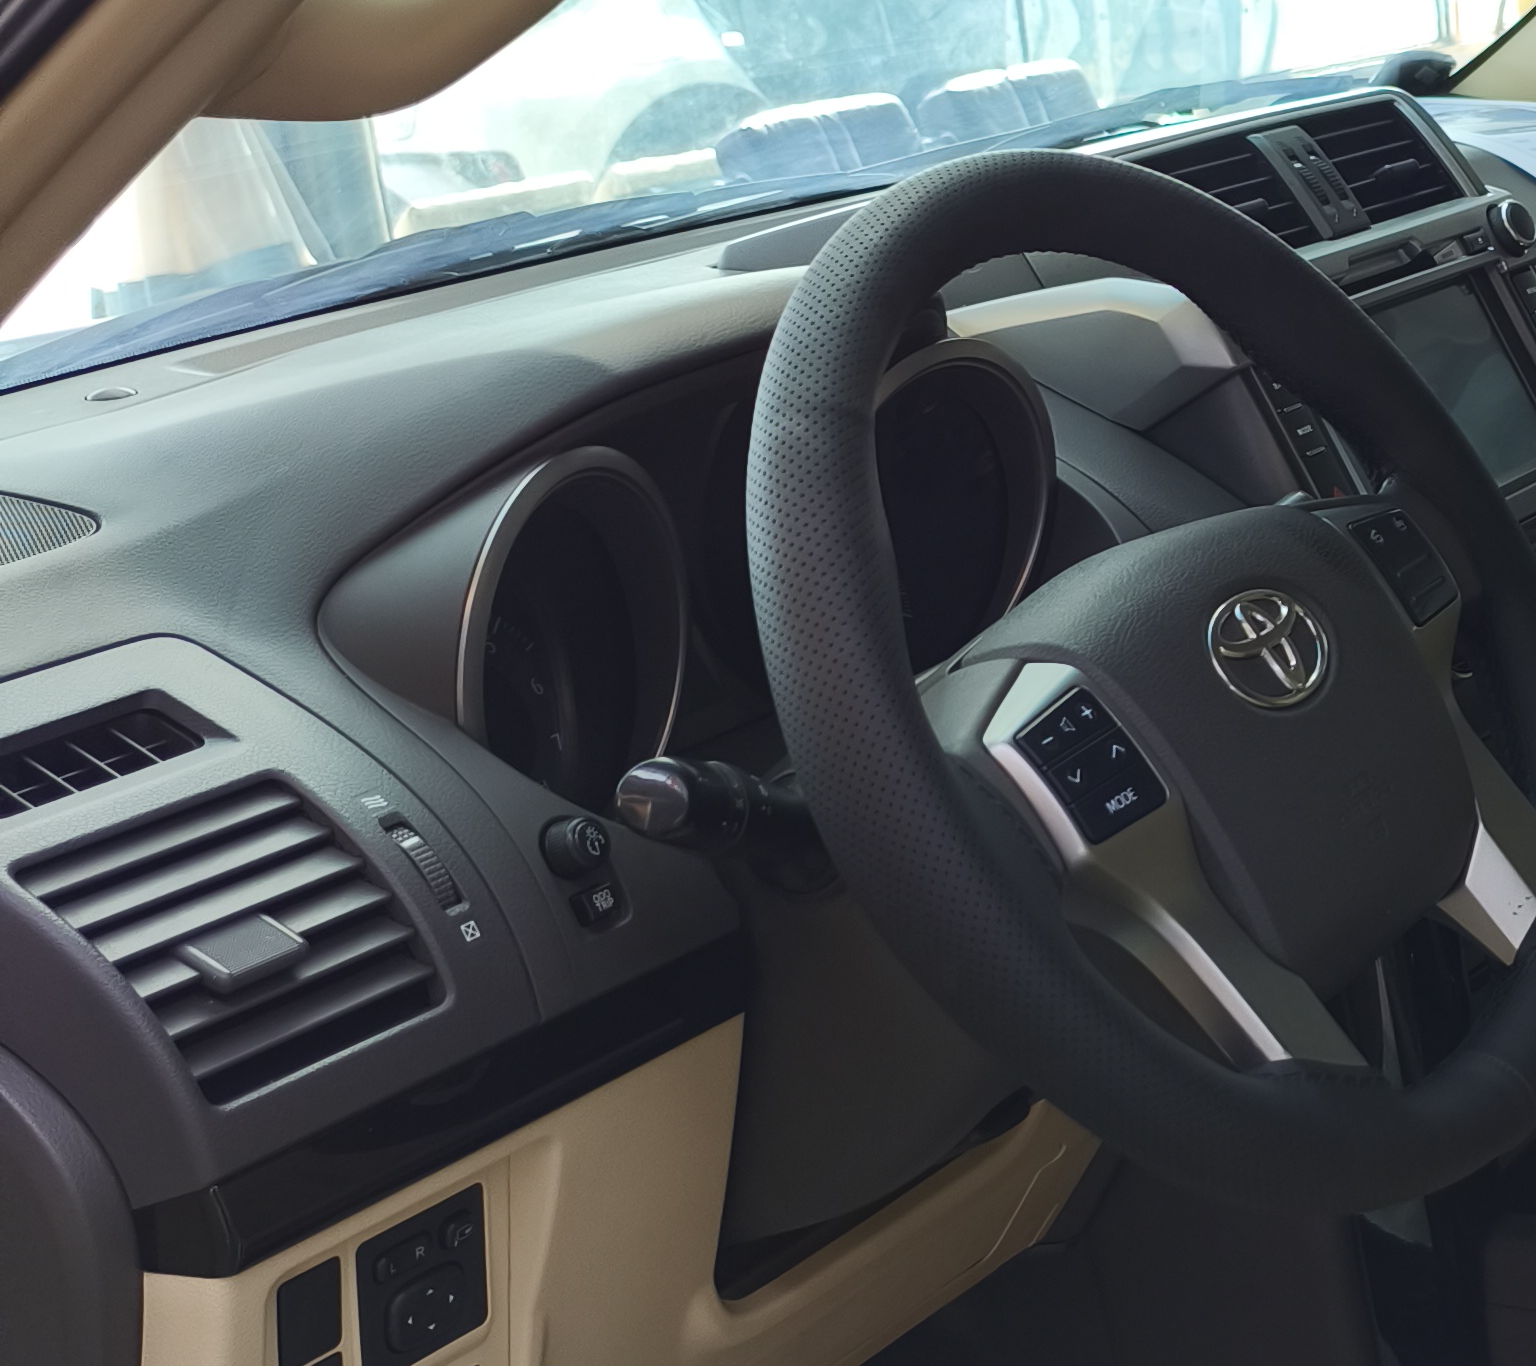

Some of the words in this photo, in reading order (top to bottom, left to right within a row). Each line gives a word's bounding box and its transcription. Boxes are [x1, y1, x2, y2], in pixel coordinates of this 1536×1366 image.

[530, 677, 544, 695] 6
[550, 732, 562, 751] 7
[1104, 786, 1139, 814] MODE
[592, 888, 611, 904] ODO
[595, 897, 615, 912] TRIP
[415, 1245, 426, 1260] R
[390, 1262, 397, 1274] L
